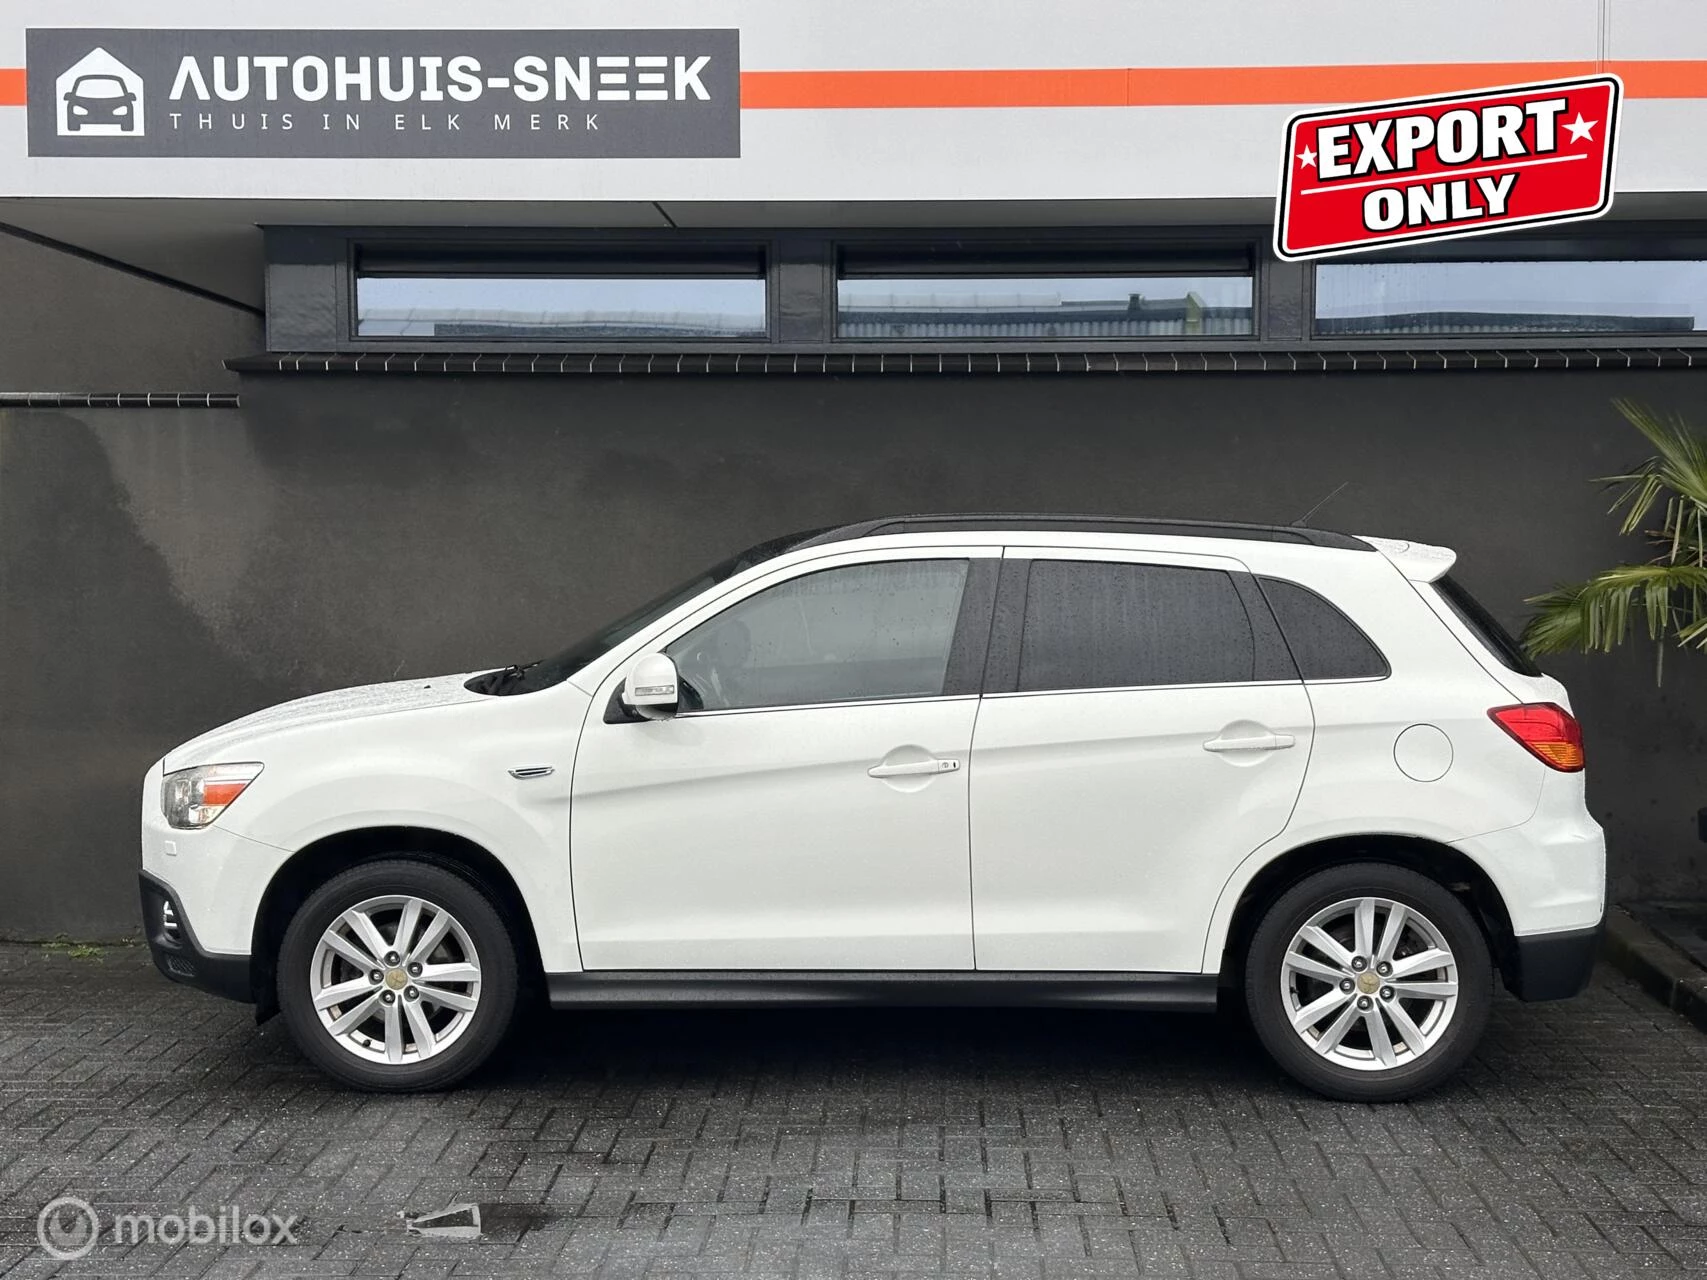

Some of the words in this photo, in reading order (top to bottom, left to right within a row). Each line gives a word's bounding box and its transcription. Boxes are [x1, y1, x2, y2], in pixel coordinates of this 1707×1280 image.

[169, 56, 711, 101] AUTOHUIS-SNEEK
[170, 113, 292, 129] THUIS
[323, 114, 359, 129] IN
[395, 114, 459, 130] ELK
[495, 114, 598, 130] MERK
